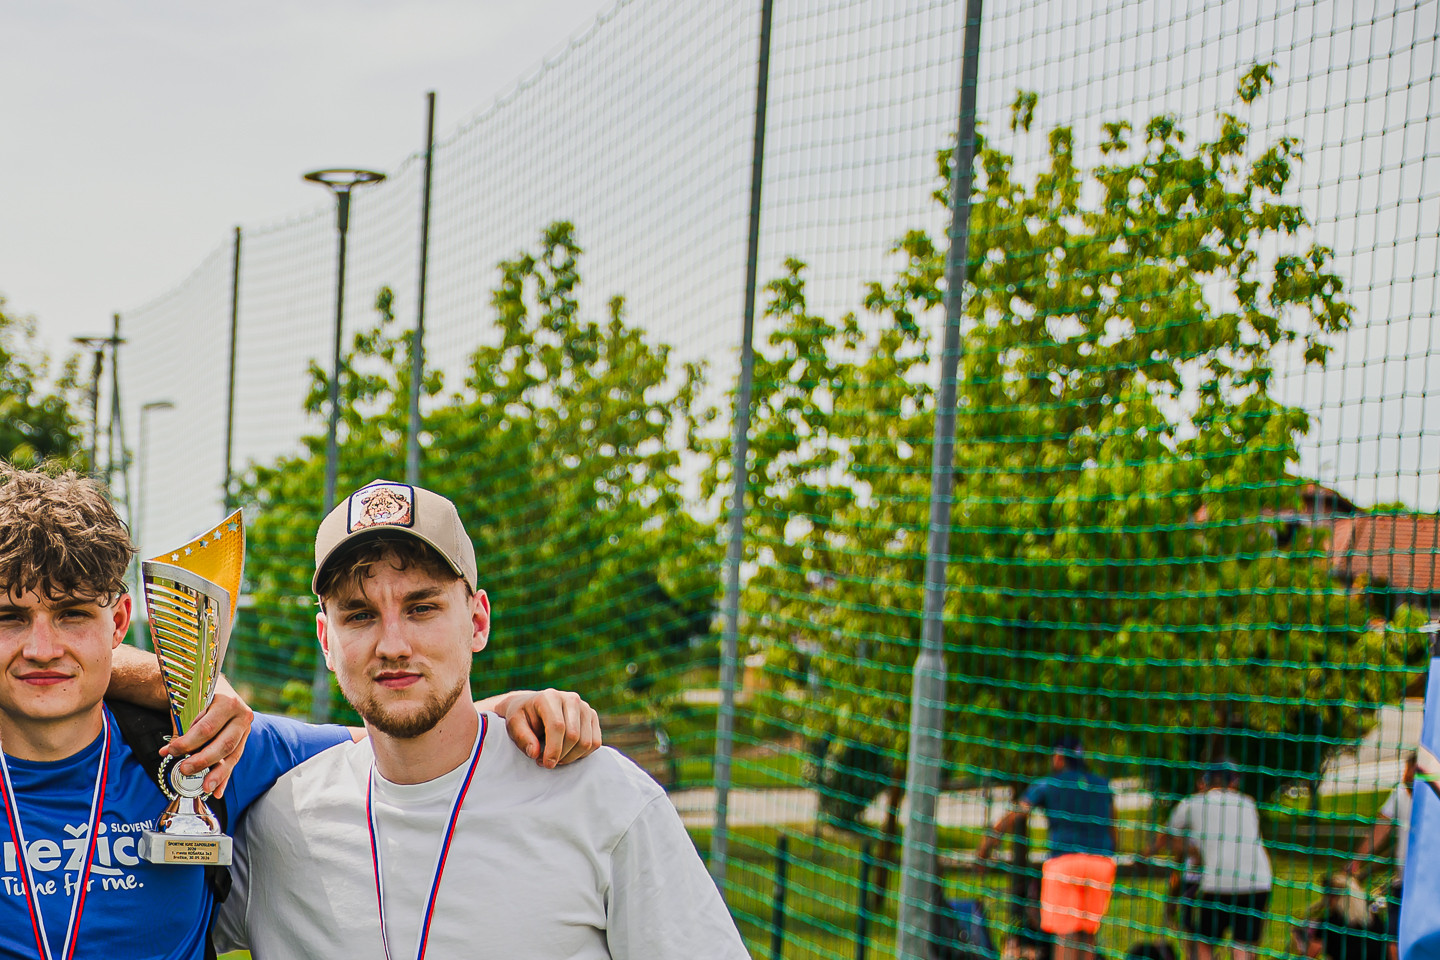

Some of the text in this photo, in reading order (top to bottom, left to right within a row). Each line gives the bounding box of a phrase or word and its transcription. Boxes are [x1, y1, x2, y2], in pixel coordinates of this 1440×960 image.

[110, 819, 154, 833] SLOVENI
[64, 873, 95, 897] fr
[102, 874, 145, 891] me.
